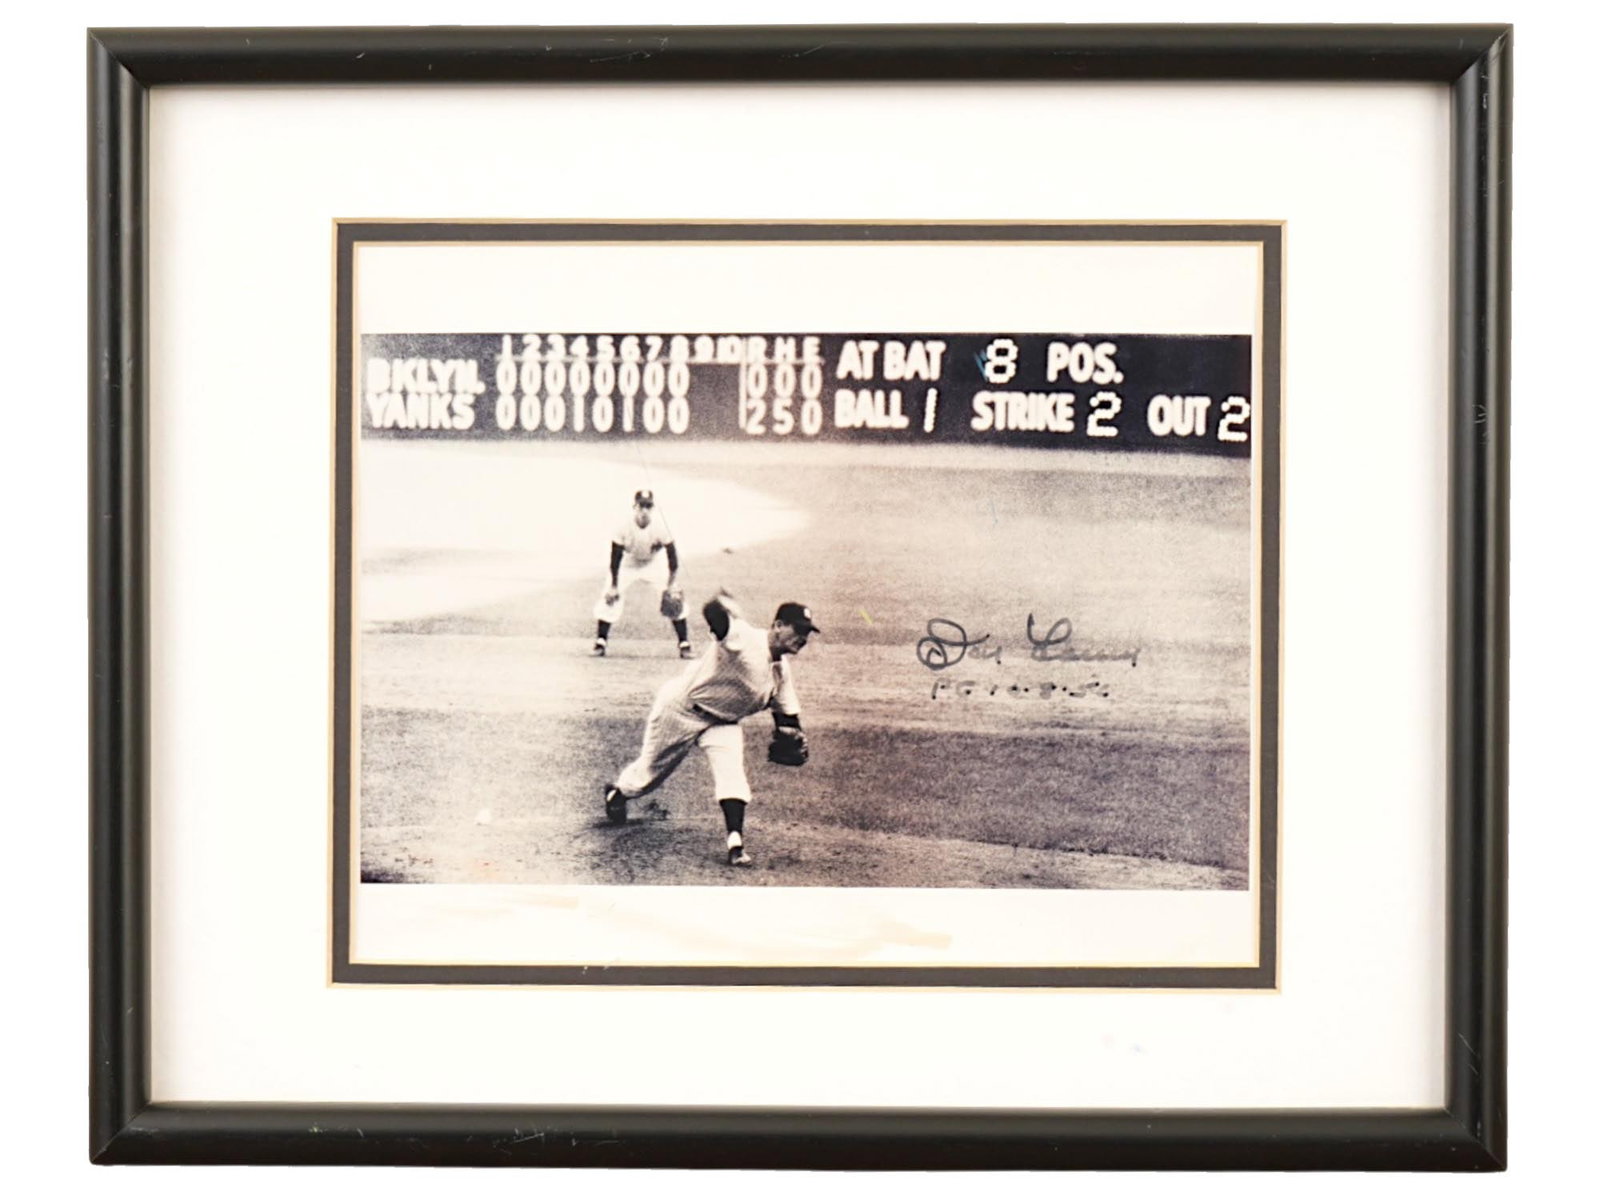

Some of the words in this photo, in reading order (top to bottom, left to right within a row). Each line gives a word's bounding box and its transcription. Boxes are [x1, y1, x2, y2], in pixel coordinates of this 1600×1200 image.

[984, 338, 1018, 383] 8
[1046, 341, 1124, 384] POS.
[366, 392, 476, 429] YANKS
[834, 388, 909, 428] BALL
[970, 390, 1075, 432] STRIKE
[1086, 391, 1122, 437] 2
[1147, 395, 1211, 436] OUT
[1217, 396, 1250, 442] 2
